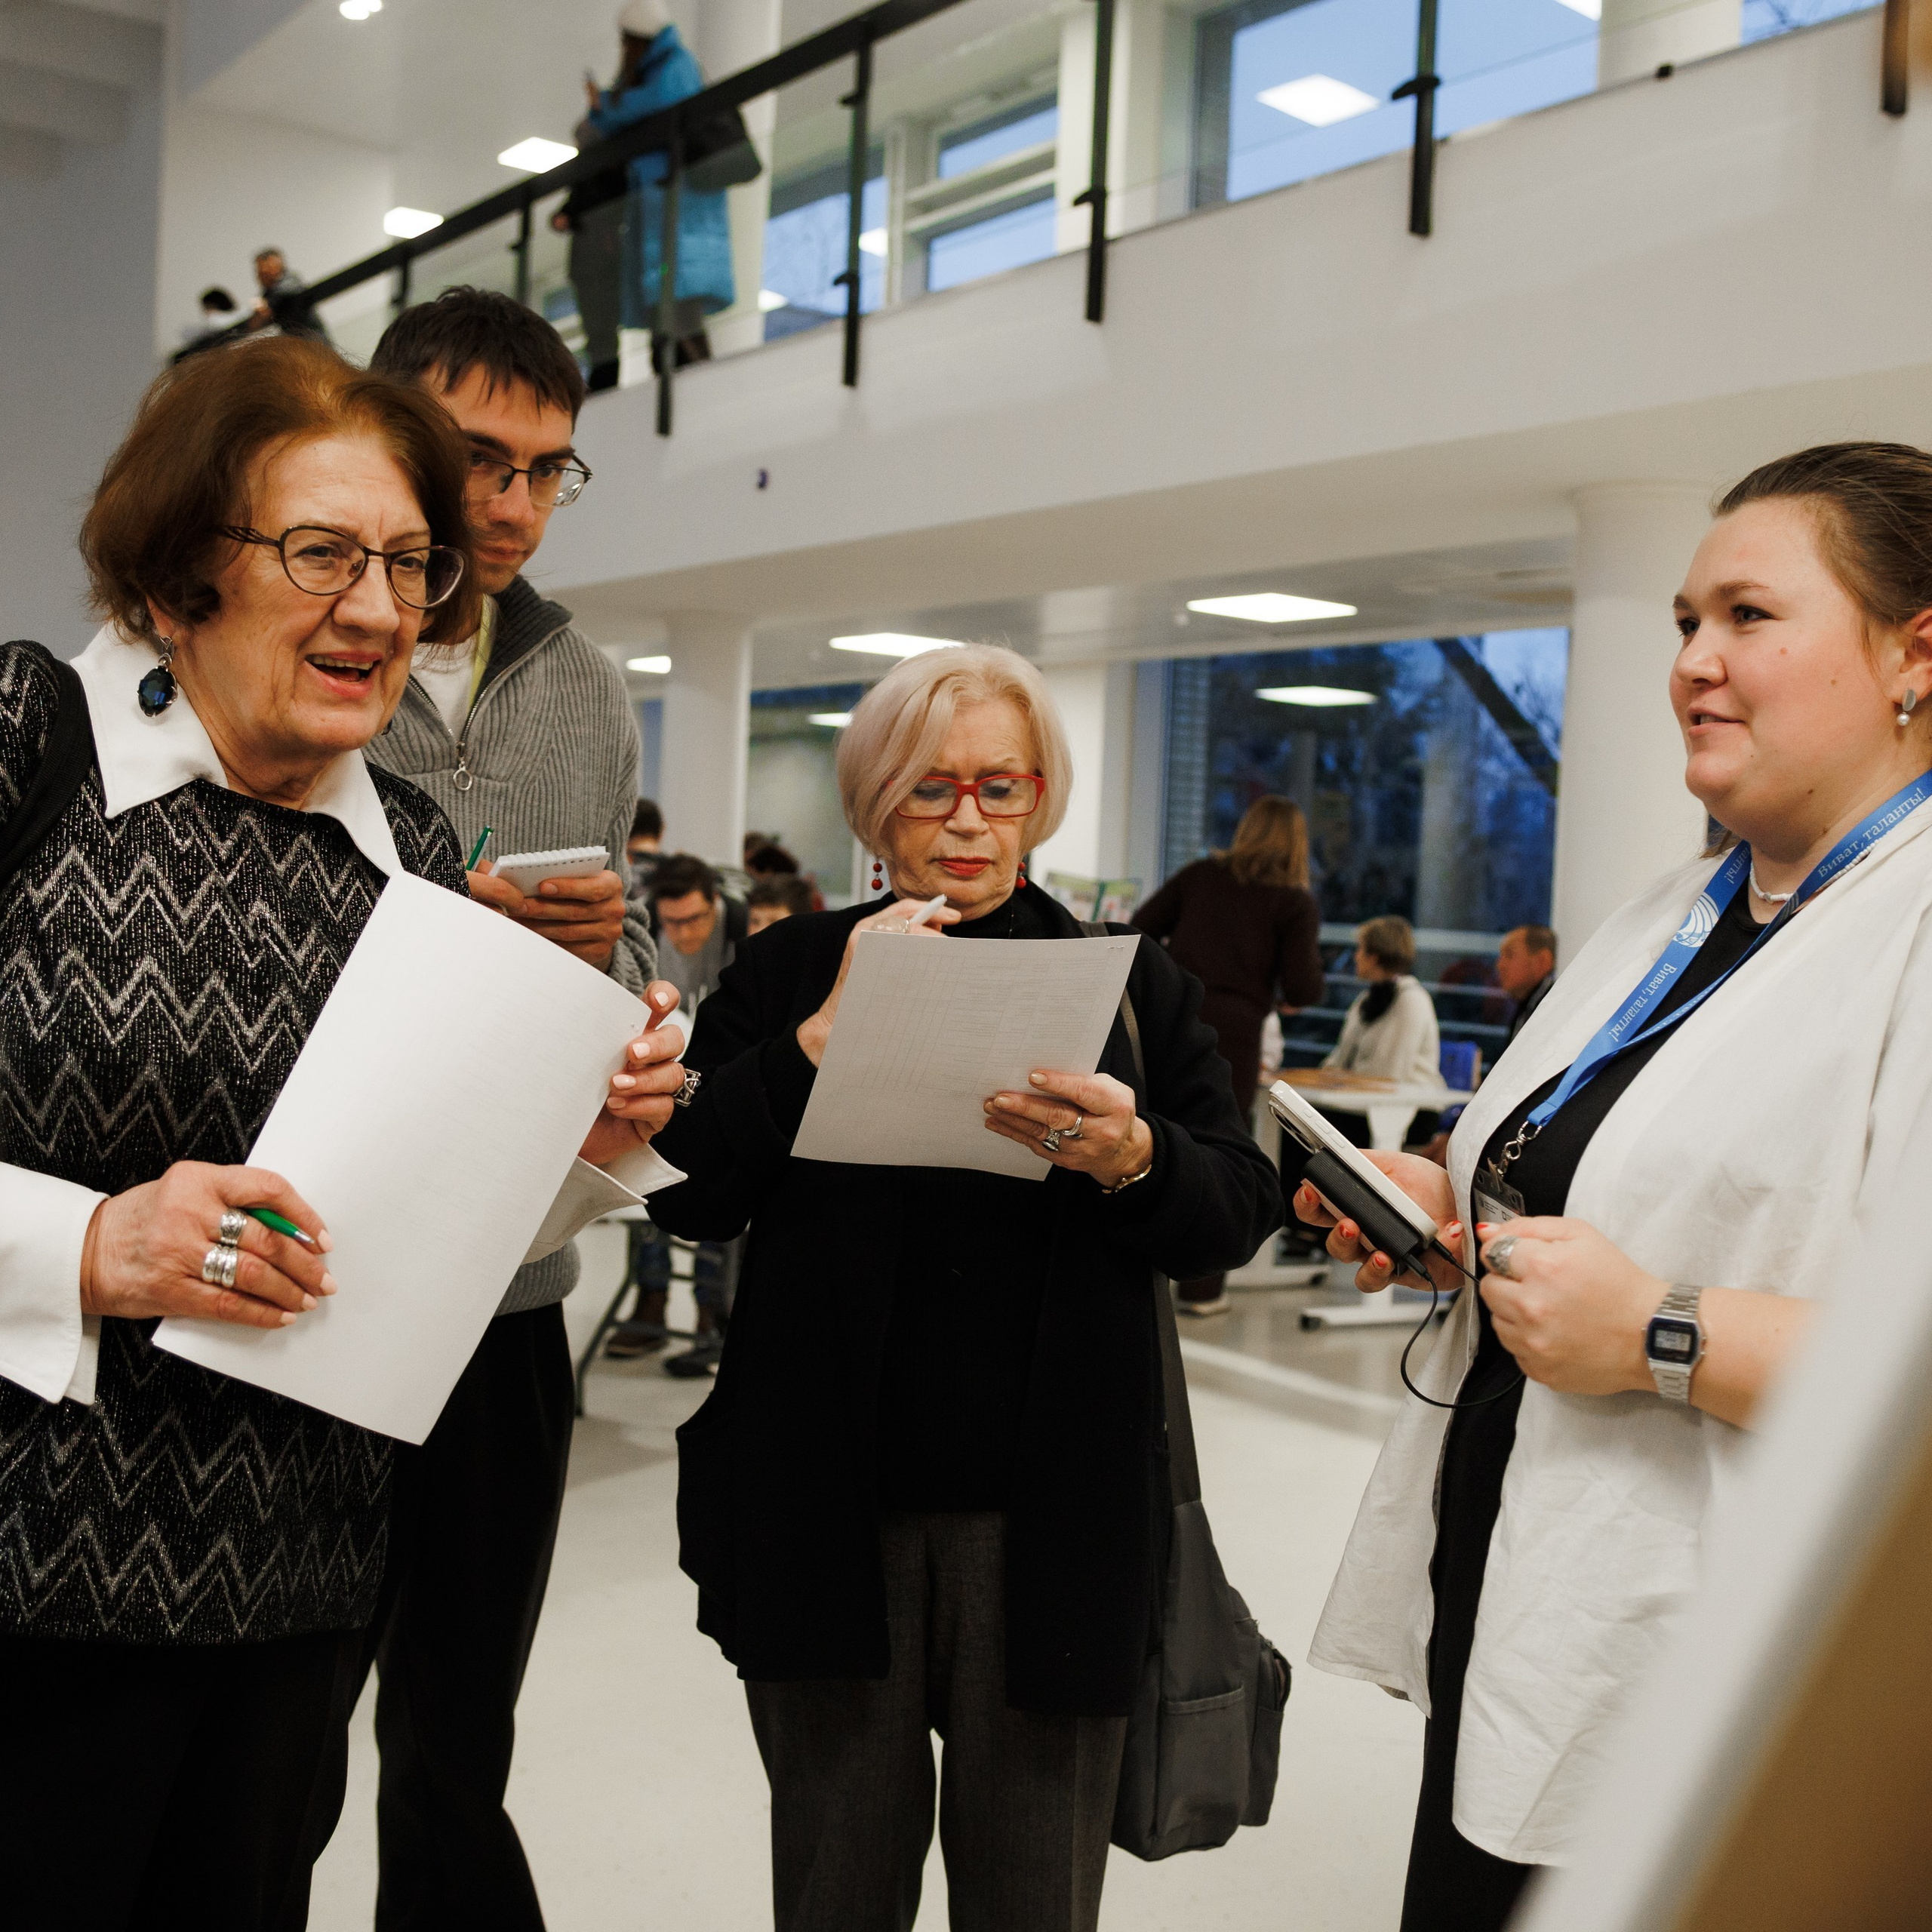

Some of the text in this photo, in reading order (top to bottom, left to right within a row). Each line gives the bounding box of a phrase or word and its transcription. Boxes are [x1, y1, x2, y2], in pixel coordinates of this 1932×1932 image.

[1818, 787, 1926, 878] Виват, таланты!
[1641, 963, 1677, 995] Виват,
[1608, 996, 1648, 1042] таланты!
